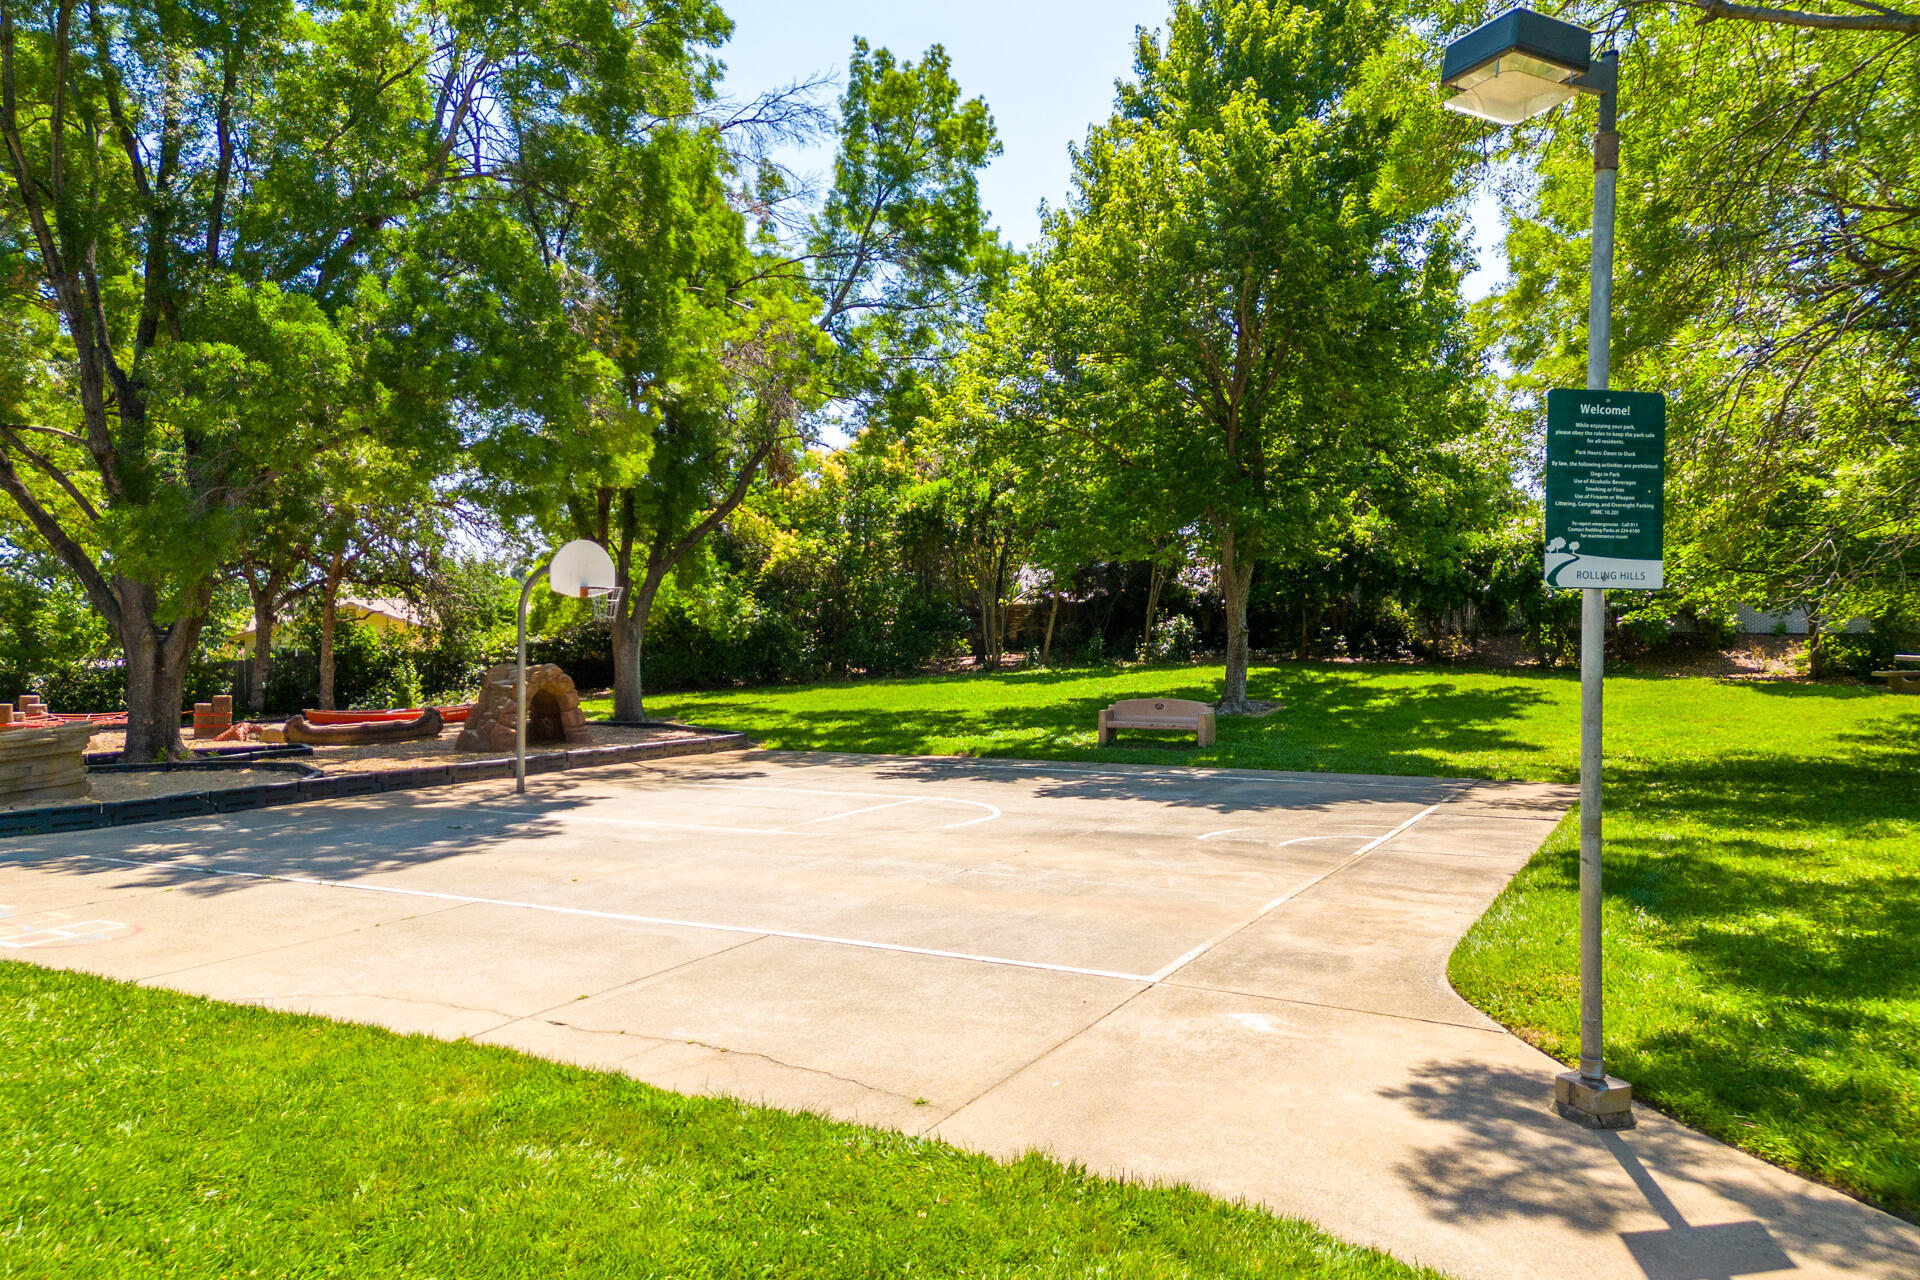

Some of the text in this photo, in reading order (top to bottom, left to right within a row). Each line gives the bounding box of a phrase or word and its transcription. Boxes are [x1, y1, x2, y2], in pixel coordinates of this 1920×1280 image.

[1580, 403, 1631, 416] Welcome!
[1612, 479, 1637, 487] Beverages
[1576, 570, 1646, 580] ROLLING HILLS
